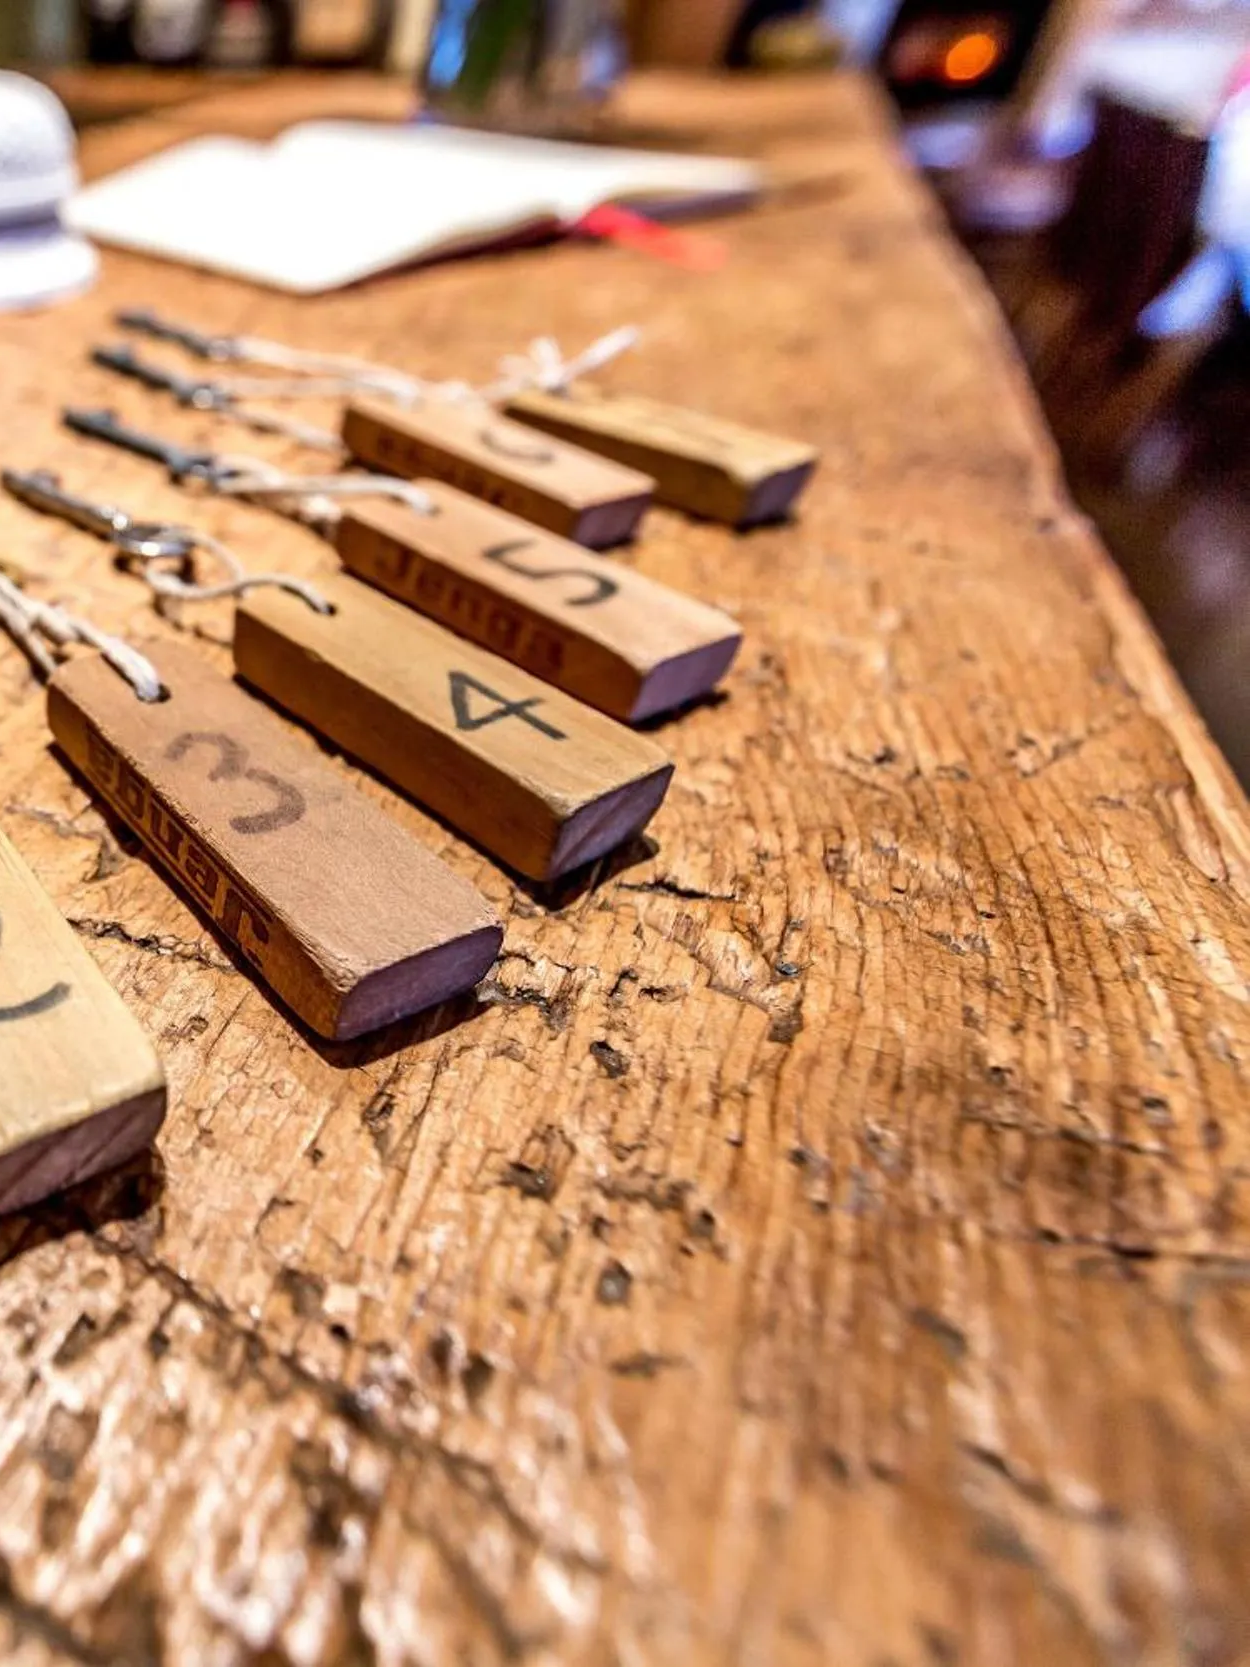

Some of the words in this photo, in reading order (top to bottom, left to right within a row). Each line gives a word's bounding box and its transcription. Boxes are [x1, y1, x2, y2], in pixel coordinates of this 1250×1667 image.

[481, 538, 618, 607] 5
[448, 670, 568, 741] 4
[165, 732, 306, 834] 3
